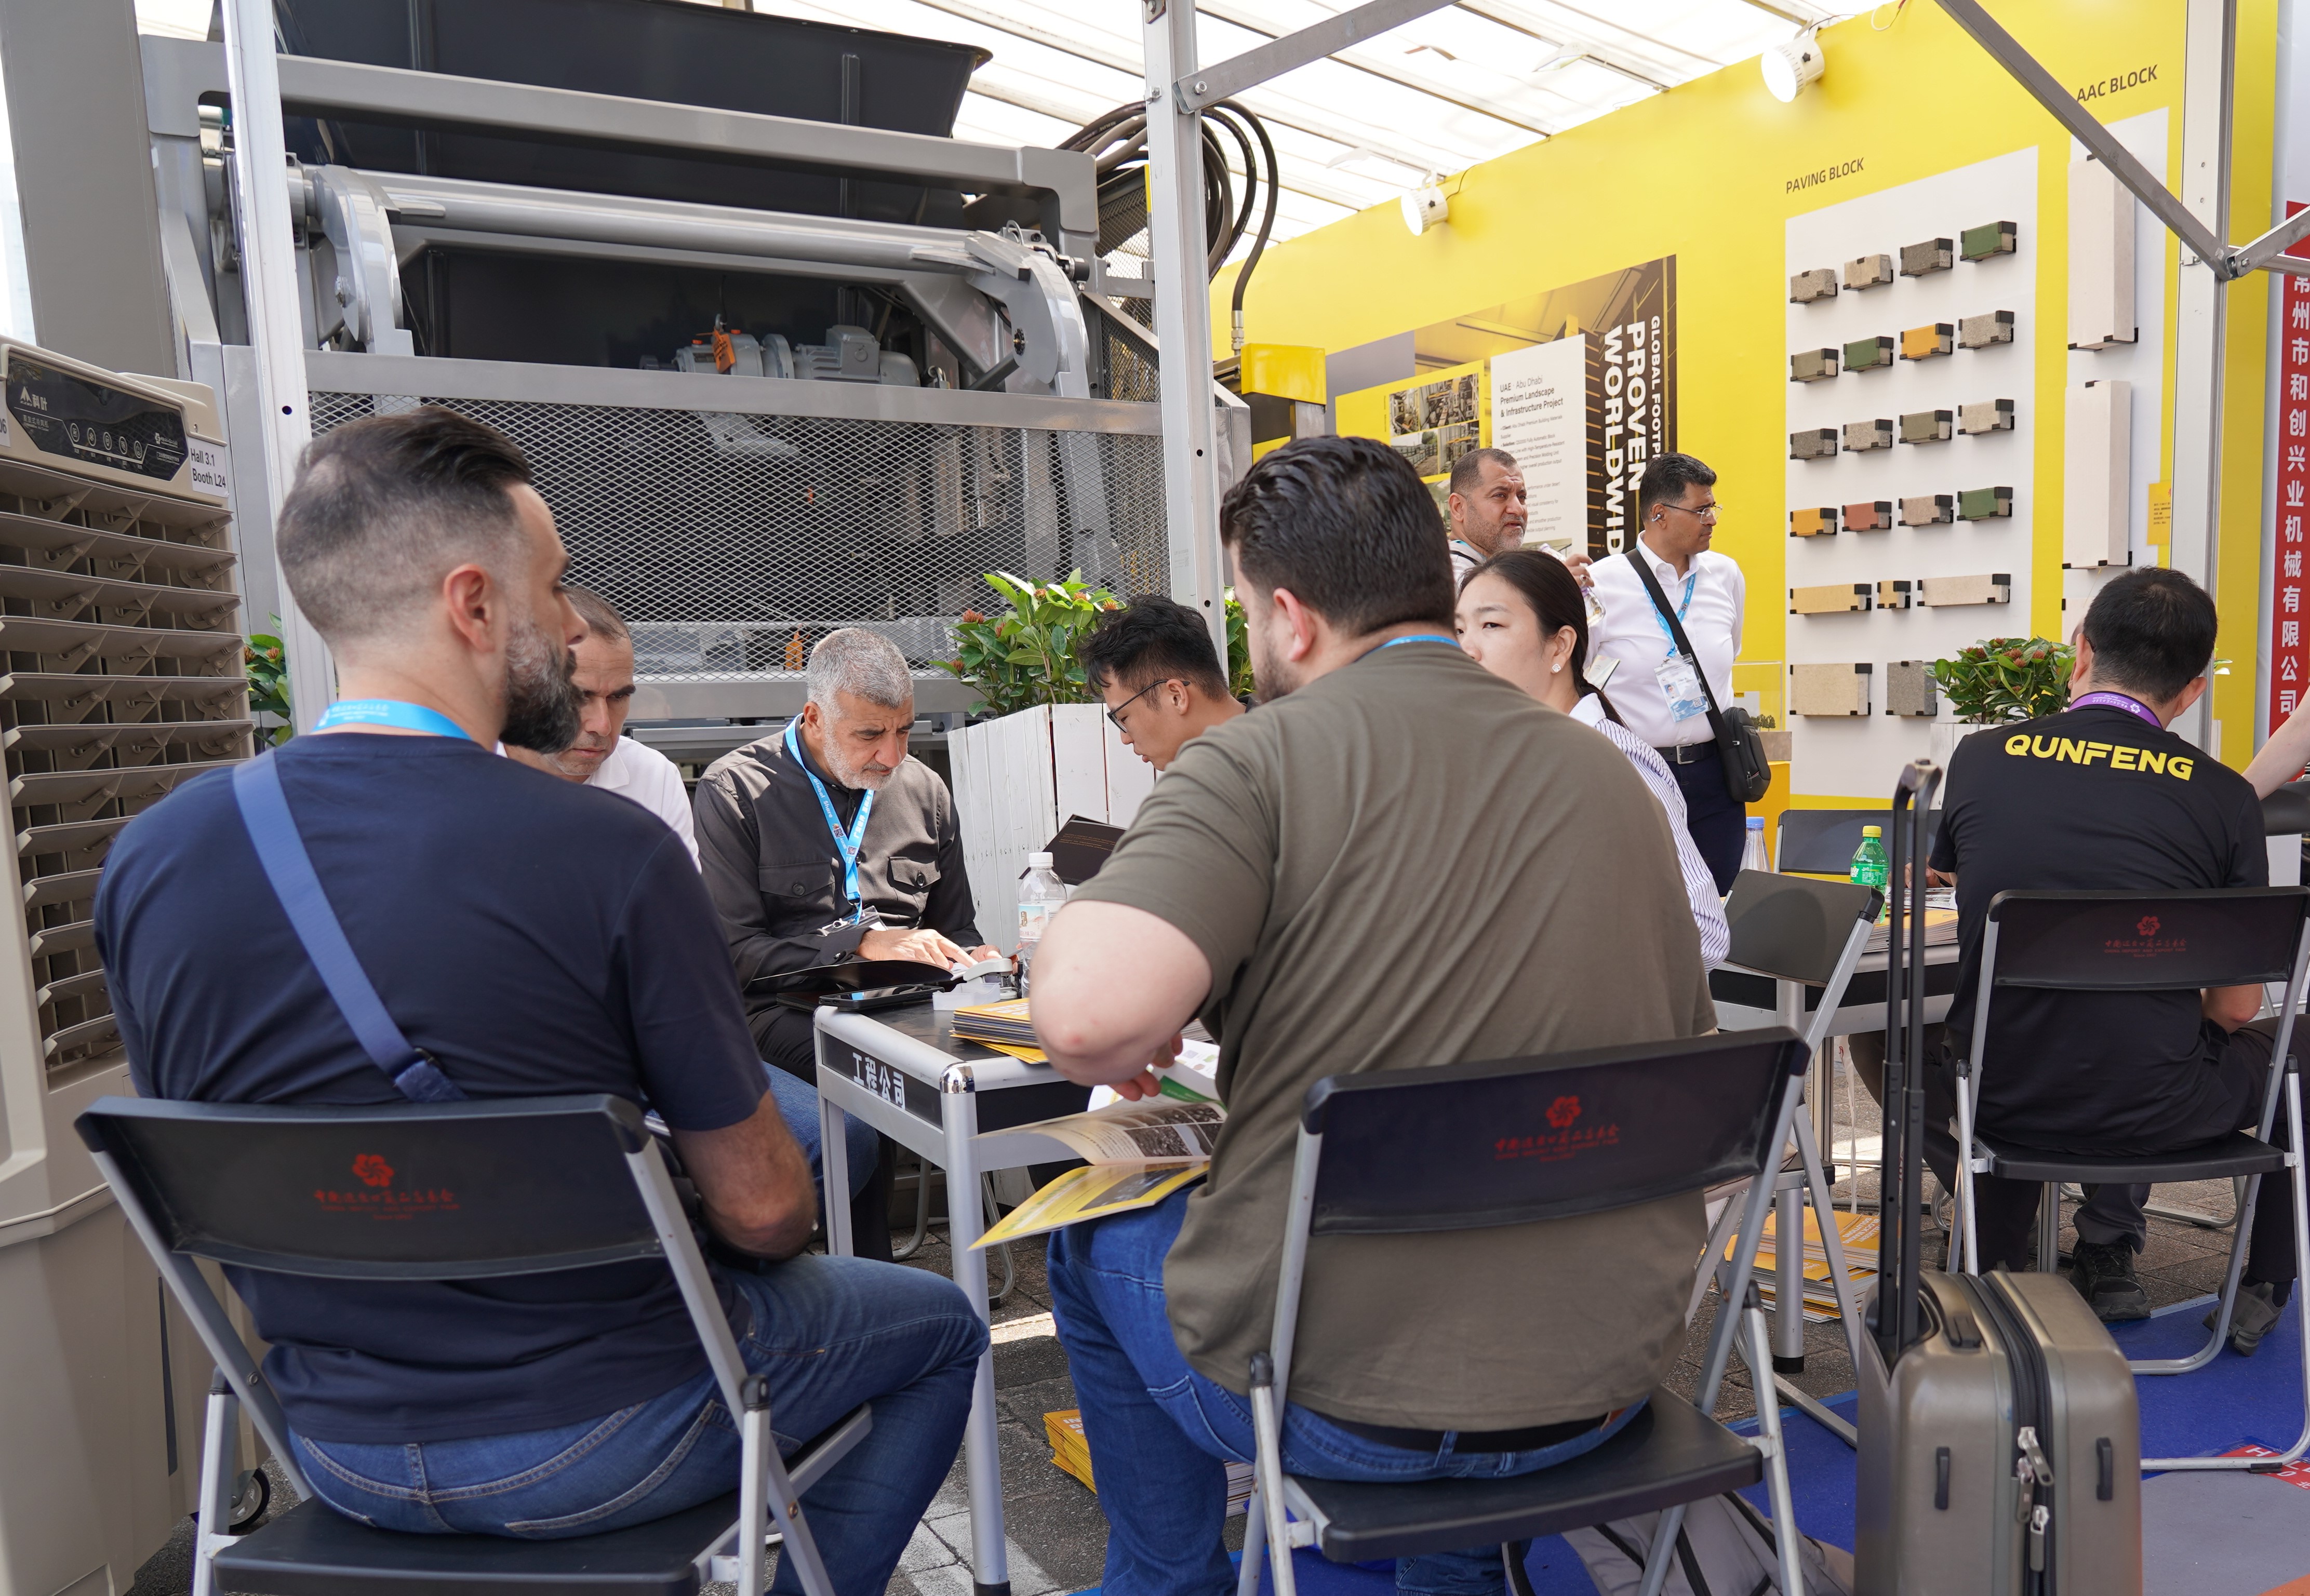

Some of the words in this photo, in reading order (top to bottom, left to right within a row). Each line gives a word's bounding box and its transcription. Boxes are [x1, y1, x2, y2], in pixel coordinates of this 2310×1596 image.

[2077, 81, 2106, 102] AAC
[2110, 64, 2158, 93] BLOCK
[1786, 170, 1826, 194] PAVING
[1829, 157, 1864, 180] BLOCK
[1651, 315, 1660, 390] GLOBAL
[1500, 383, 1511, 392] UAE
[1527, 375, 1543, 386] Dhabi
[1500, 394, 1523, 405] Premium
[1525, 387, 1554, 399] Landscape
[1506, 403, 1542, 416] Infrastructure
[1543, 397, 1563, 409] Project
[1627, 321, 1646, 491] PROVEN
[190, 448, 204, 464] Hall
[205, 452, 215, 466] 3.1
[1605, 325, 1624, 555] WORLDWID
[192, 467, 213, 485] Booth
[214, 473, 226, 488] L24
[2005, 734, 2194, 781] QUNFENG
[813, 779, 825, 798] Global
[823, 800, 833, 818] Share
[852, 1052, 905, 1110] 工程公司
[1857, 1225, 1880, 1242] ELLIGENT
